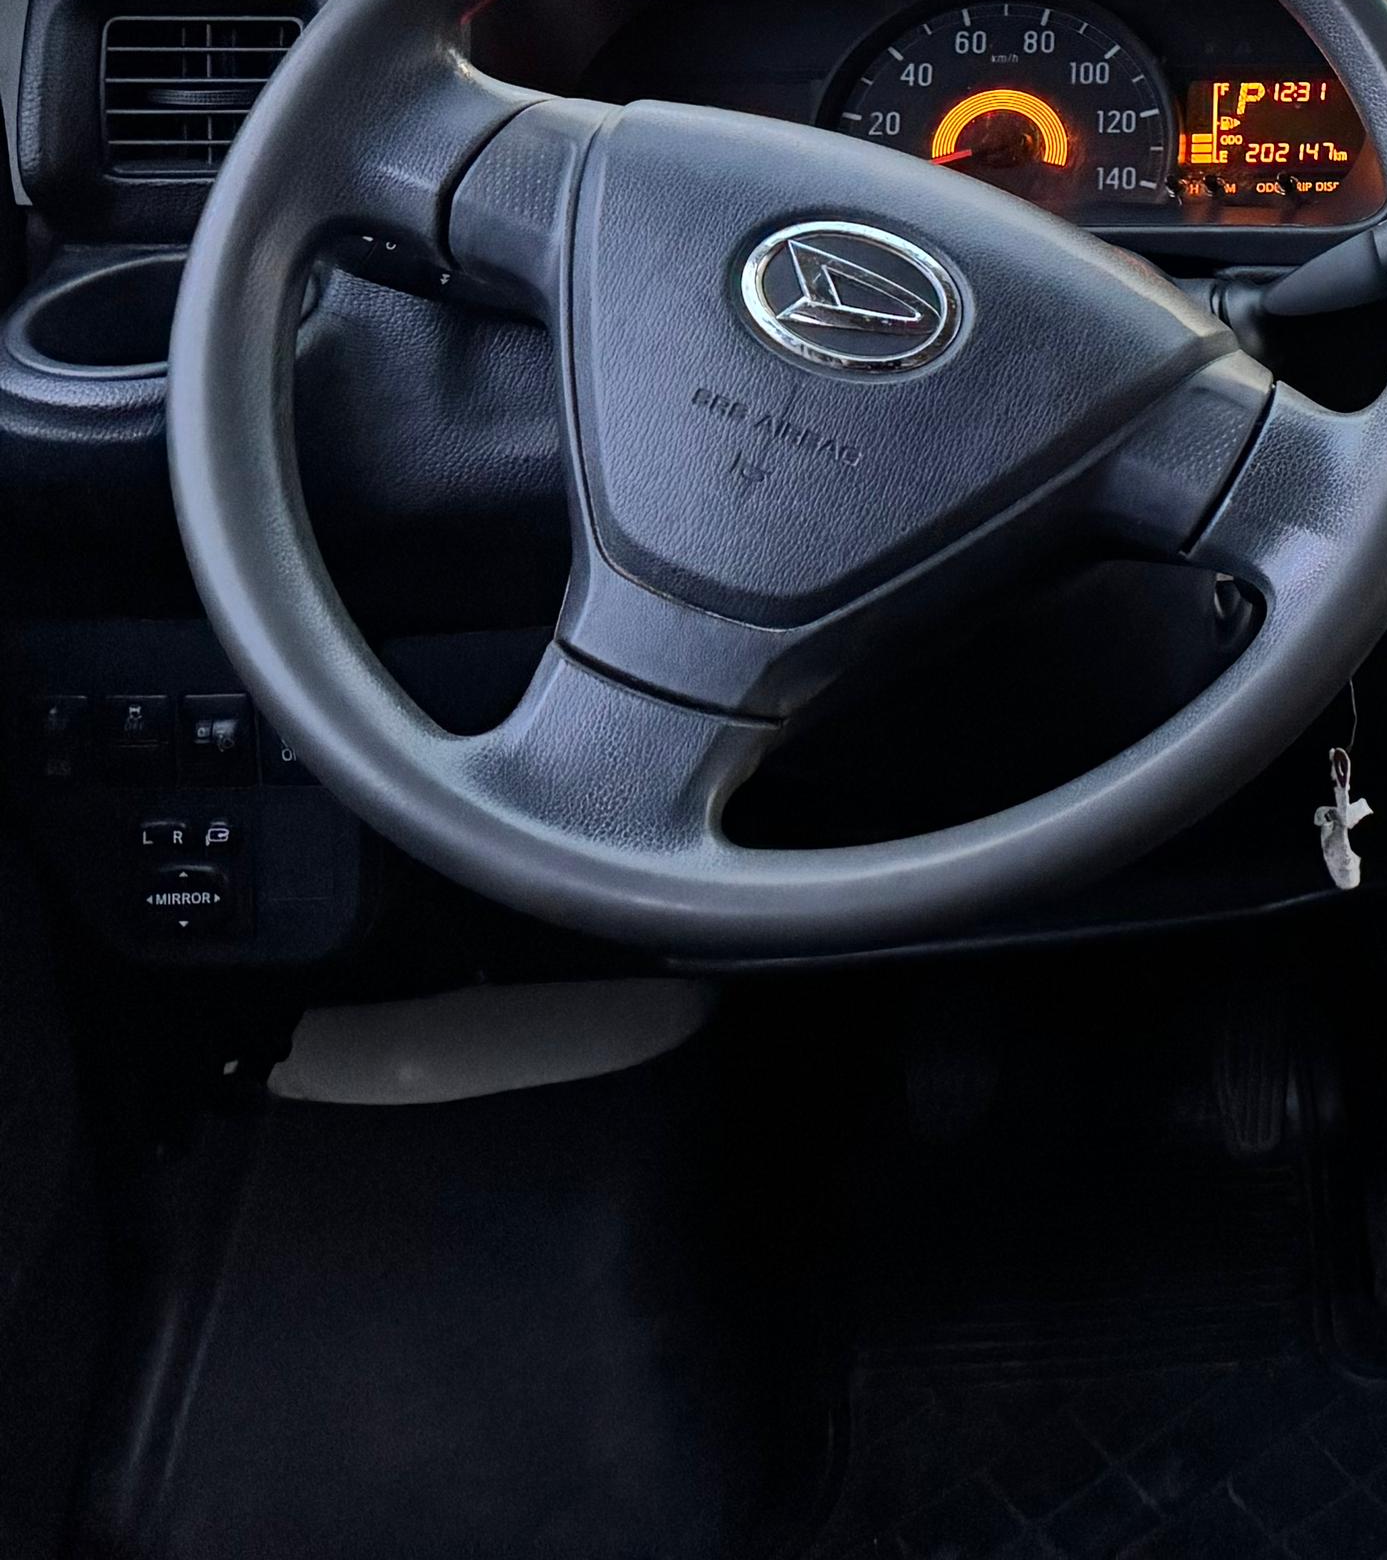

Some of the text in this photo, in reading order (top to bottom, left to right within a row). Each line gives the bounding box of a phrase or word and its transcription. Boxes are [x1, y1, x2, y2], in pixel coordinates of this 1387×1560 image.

[955, 30, 987, 54] 60
[1023, 30, 1055, 53] 80
[991, 53, 1019, 63] km/h
[900, 62, 933, 86] 40
[1069, 61, 1110, 85] 100
[1220, 83, 1230, 96] F
[1273, 82, 1327, 102] 12:31
[1236, 82, 1266, 115] P
[868, 111, 900, 136] 20
[1096, 110, 1137, 133] 120
[1219, 135, 1243, 145] ODO
[1219, 150, 1229, 163] E
[1333, 149, 1348, 161] km
[1096, 167, 1137, 190] 140
[1190, 183, 1199, 194] H
[1224, 183, 1236, 194] M
[142, 830, 183, 845] L R
[155, 892, 211, 905] MIRROR
